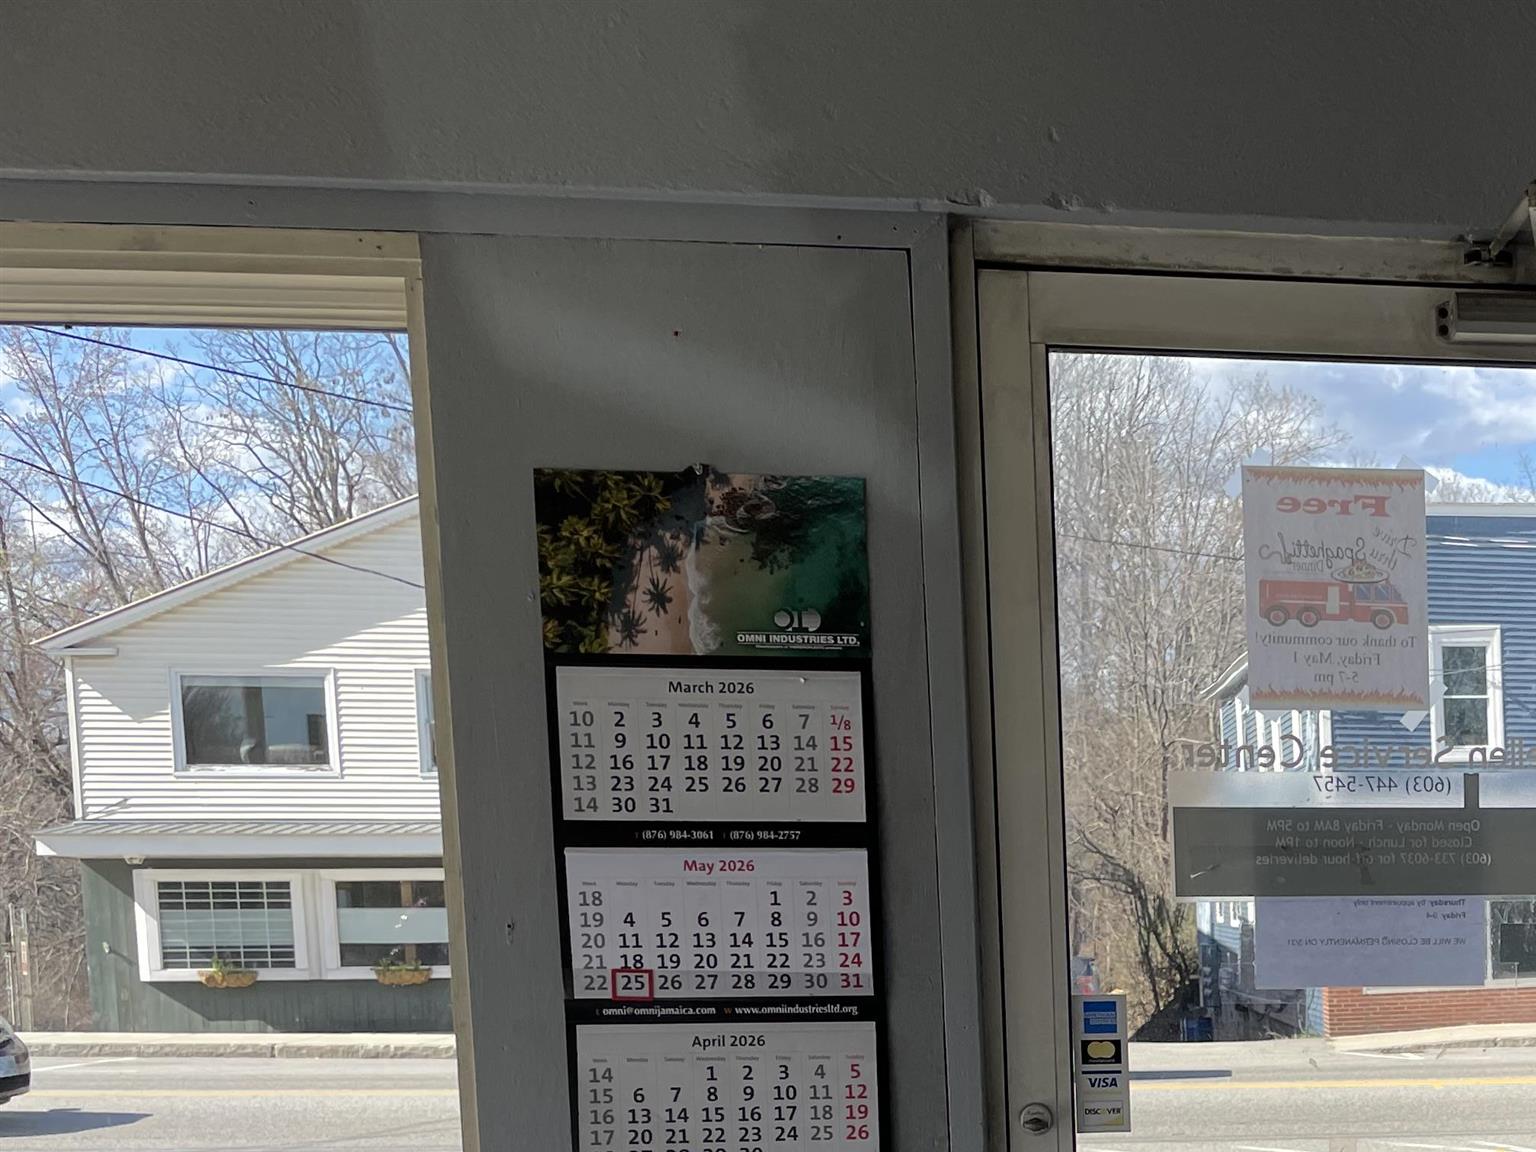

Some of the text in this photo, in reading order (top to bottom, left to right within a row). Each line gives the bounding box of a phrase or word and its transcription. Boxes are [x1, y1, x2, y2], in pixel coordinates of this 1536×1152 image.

[737, 634, 860, 645] OMNI INDUSTRIES LTD.
[668, 681, 754, 694] March 2026
[642, 830, 714, 840] (876) 984-3061
[730, 830, 801, 840] (876) 984-2757
[683, 860, 755, 874] May 2026
[579, 890, 853, 906] 18 1 2 3
[580, 911, 860, 927] 19 4 5 6 7 8 9 10
[581, 932, 860, 949] 20 11 12 13 14 15 16 17
[583, 953, 862, 969] 21 18 19 20 21 22 23 24
[584, 973, 863, 991] 22 25 26 27 28 29 30 31
[734, 1005, 858, 1016] www.omniindustriesltd.org
[692, 1035, 766, 1051] April 2026
[1088, 1078, 1118, 1088] VISA
